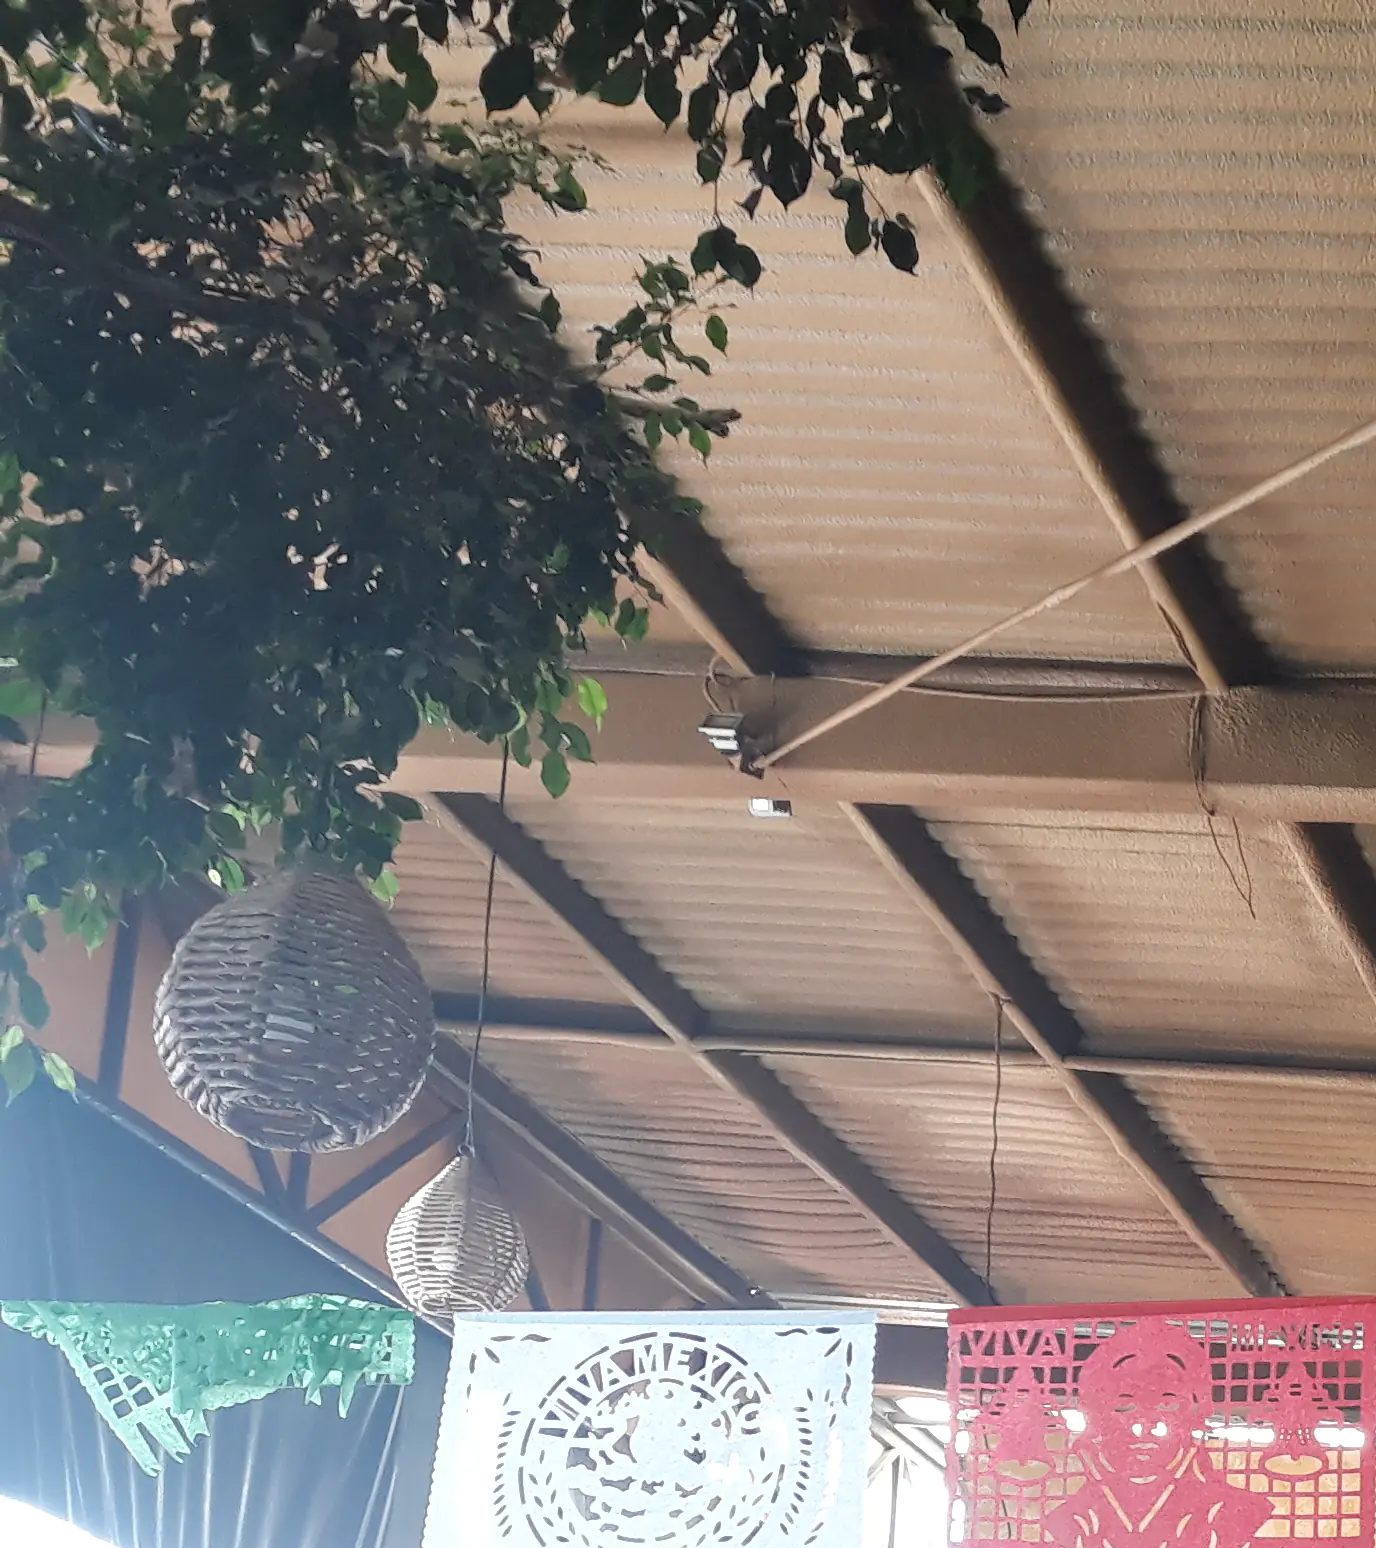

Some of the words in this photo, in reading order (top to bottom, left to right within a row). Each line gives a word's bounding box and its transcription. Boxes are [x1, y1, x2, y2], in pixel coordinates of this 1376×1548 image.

[963, 1328, 1063, 1357] VIVA
[537, 1358, 622, 1438] VIVA
[634, 1342, 763, 1437] MEXICO
